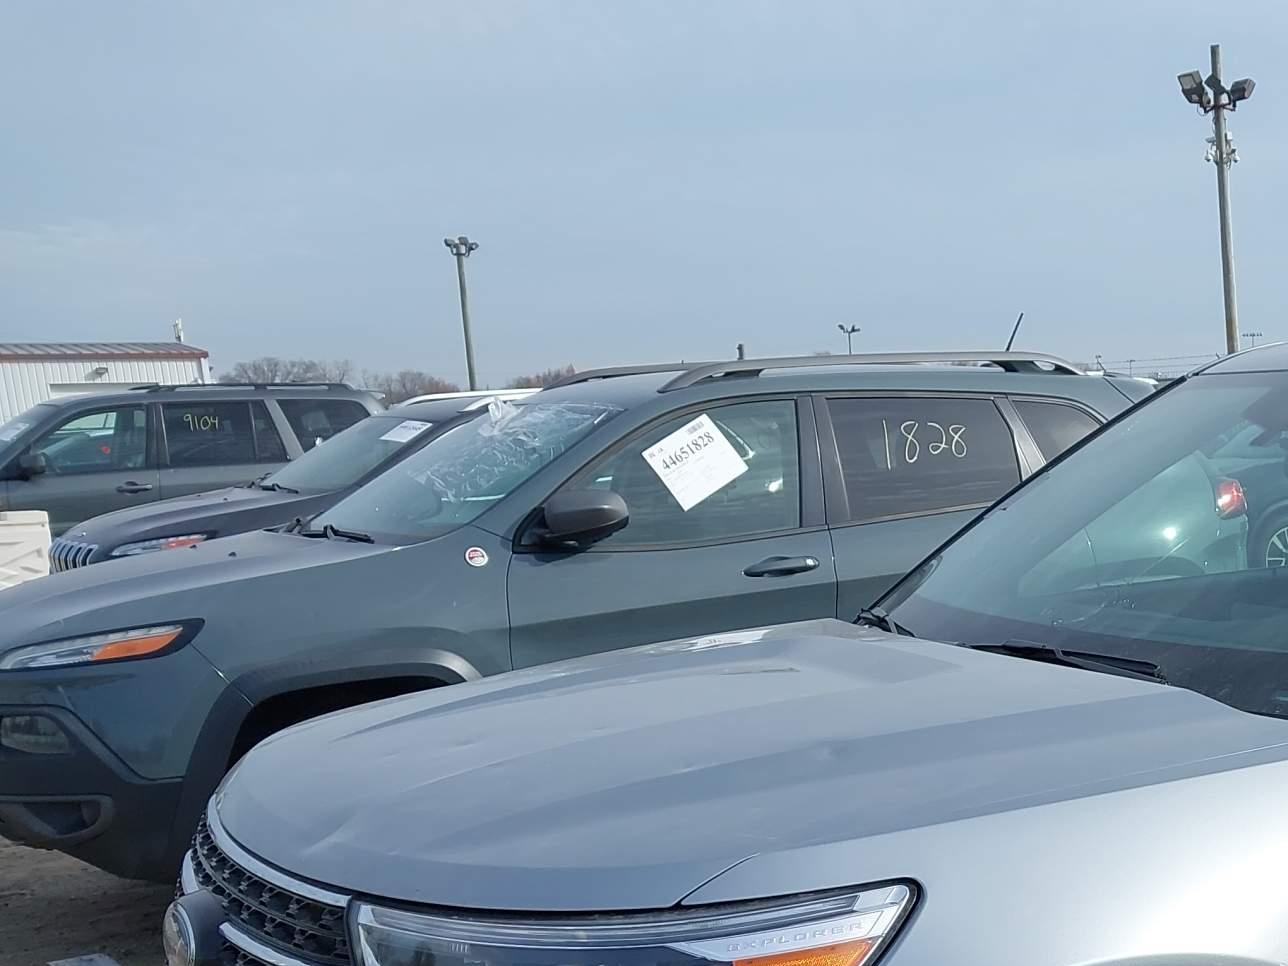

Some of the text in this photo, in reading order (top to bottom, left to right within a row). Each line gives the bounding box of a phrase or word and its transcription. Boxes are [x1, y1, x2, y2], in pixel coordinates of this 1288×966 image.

[183, 413, 218, 432] 9104
[662, 431, 715, 470] 44651828
[882, 419, 968, 471] 1828
[727, 919, 864, 953] EXPLORER
